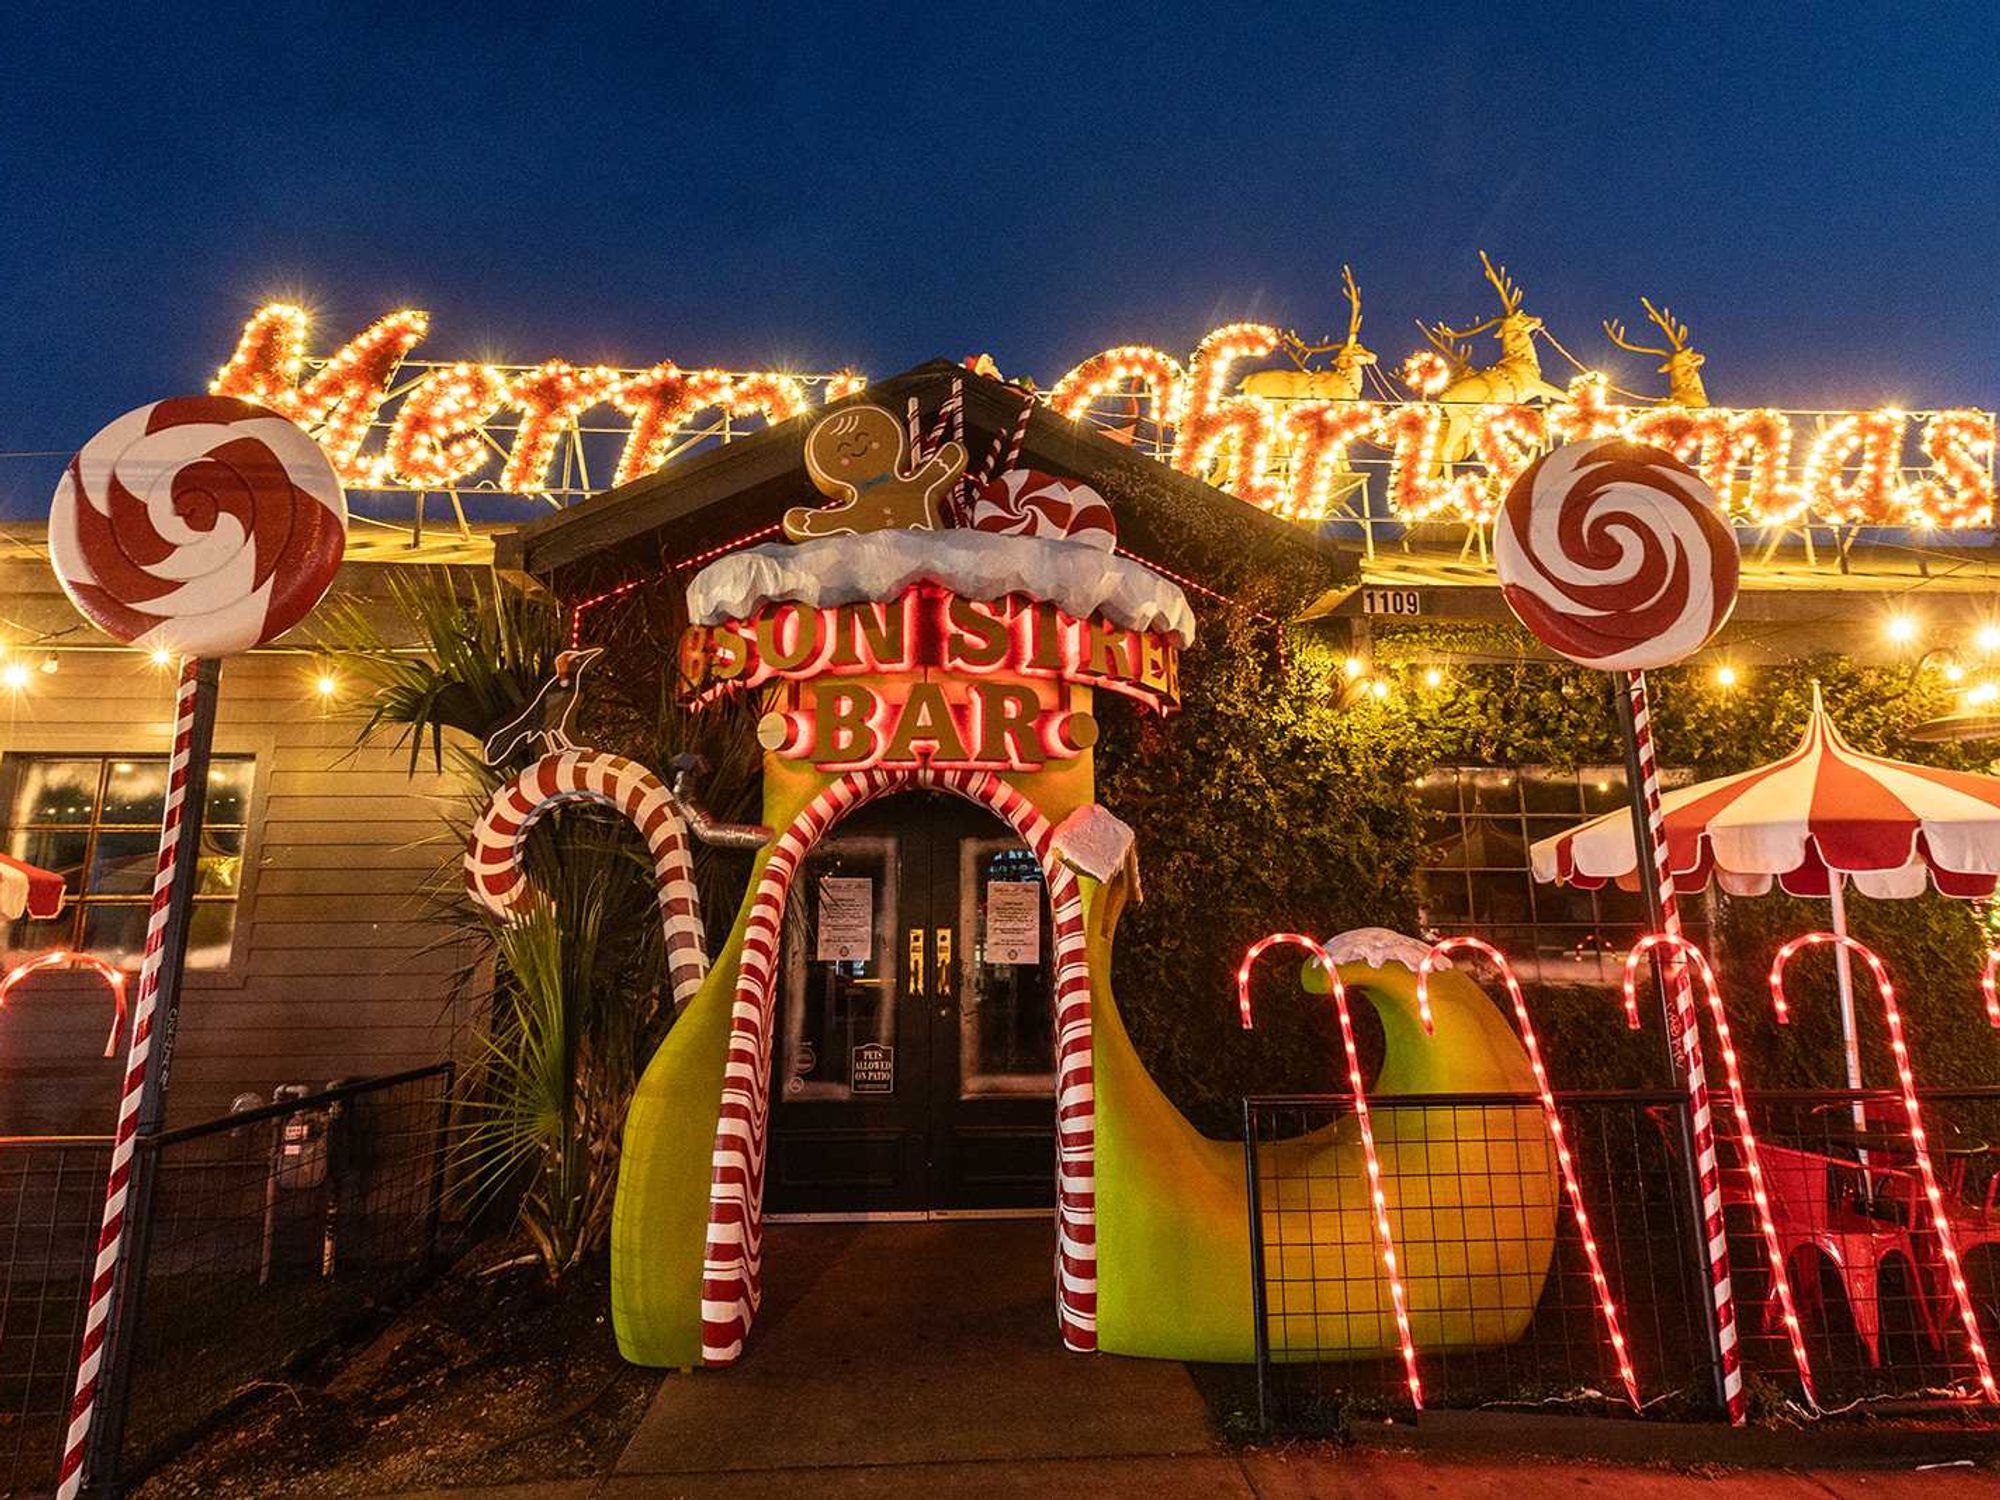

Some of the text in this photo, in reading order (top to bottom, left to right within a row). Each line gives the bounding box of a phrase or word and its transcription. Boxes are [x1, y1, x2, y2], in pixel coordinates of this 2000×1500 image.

[206, 301, 868, 494] Merr
[1366, 591, 1418, 614] 1109
[808, 681, 1047, 764] BAR
[863, 1050, 883, 1060] PETS
[855, 1061, 892, 1071] ALLOWED
[854, 1071, 891, 1081] ON PATIO
